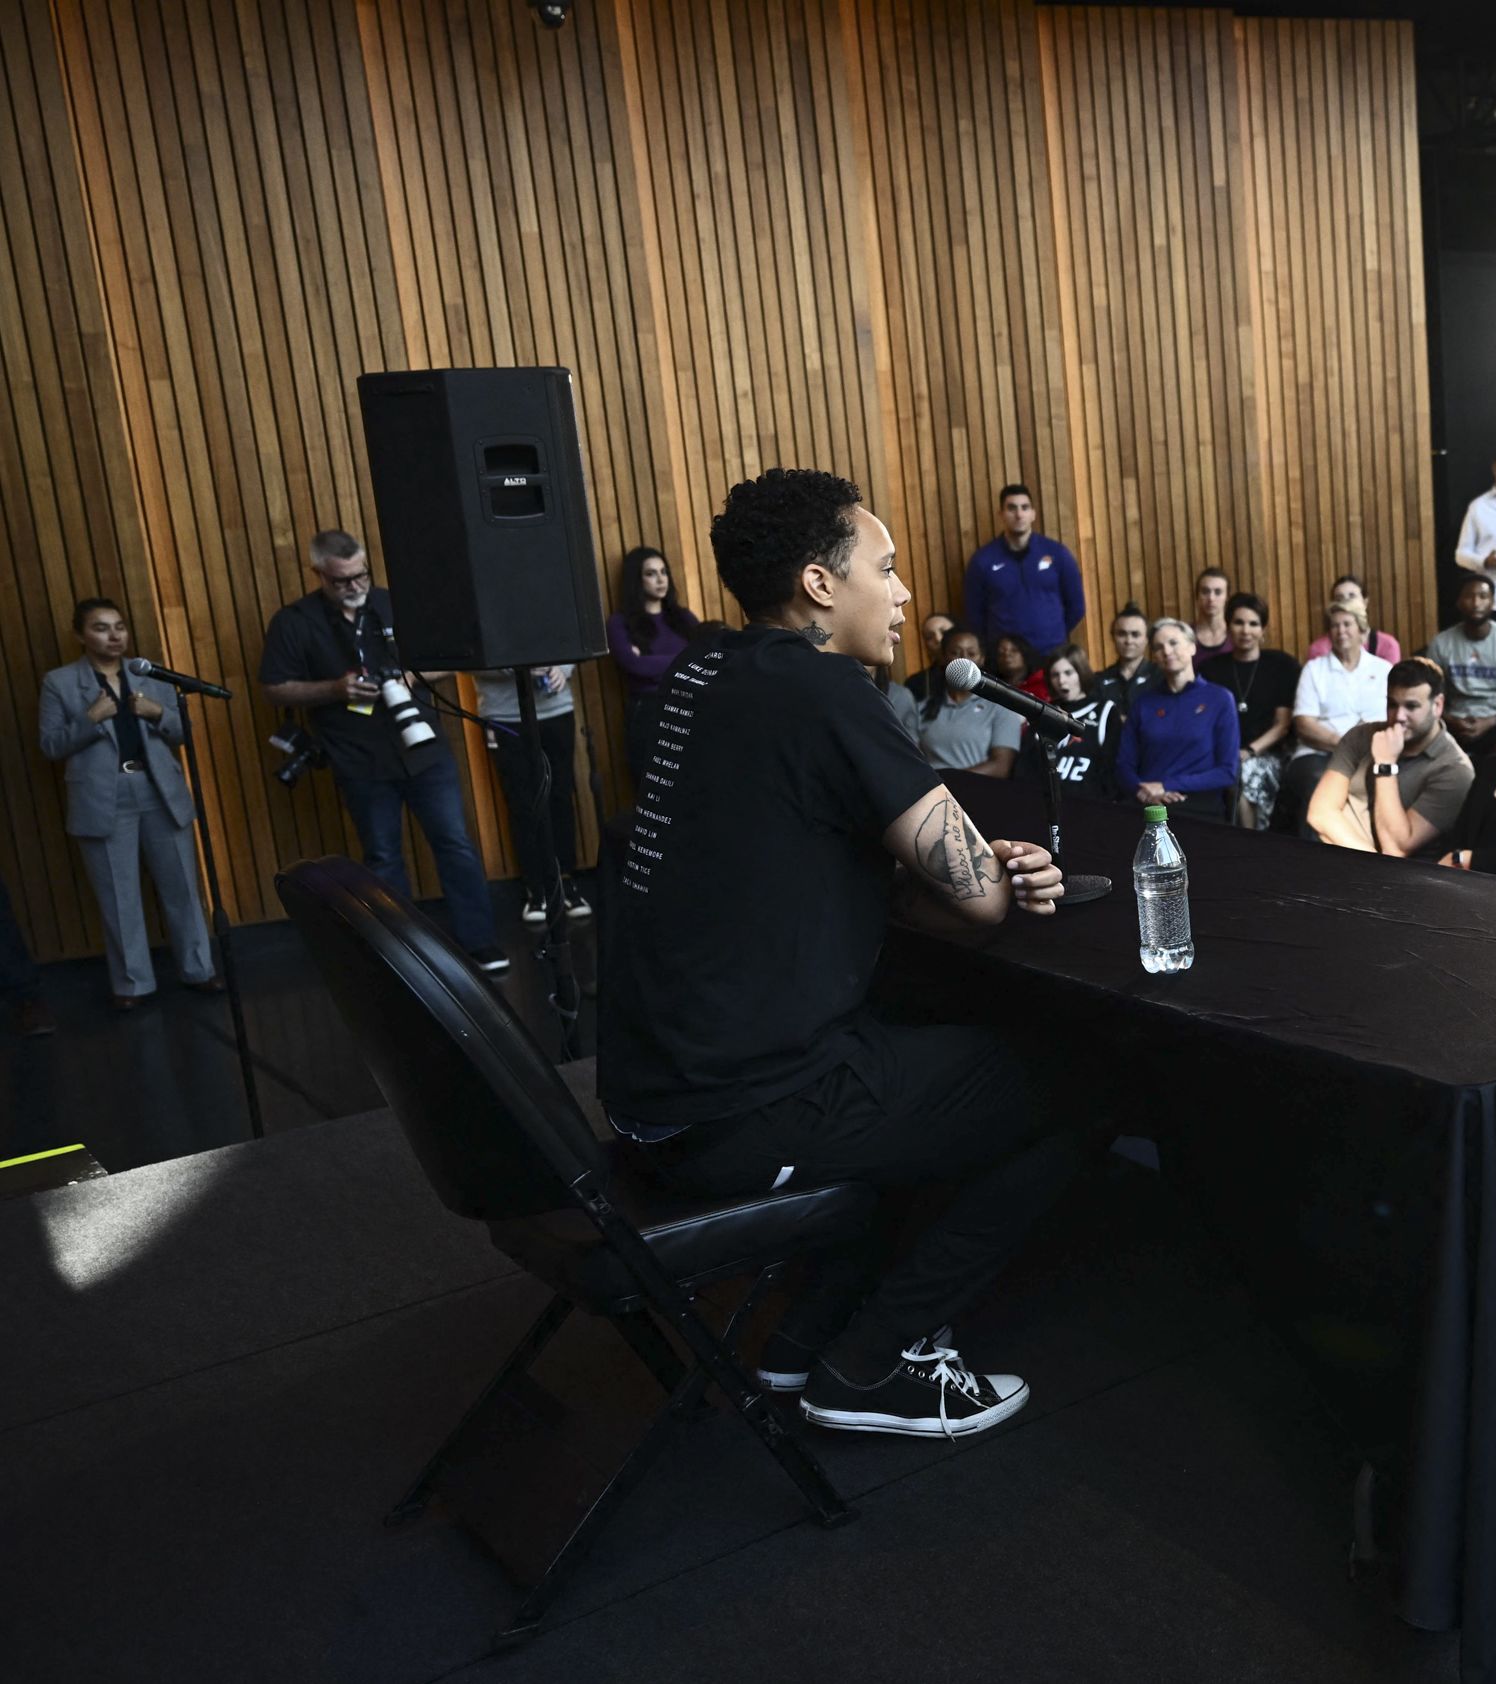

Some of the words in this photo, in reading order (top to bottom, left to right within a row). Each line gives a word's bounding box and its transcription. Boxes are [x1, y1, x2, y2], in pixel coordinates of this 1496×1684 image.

[1056, 756, 1091, 782] 42
[644, 811, 672, 825] HERNANDEZ
[953, 827, 962, 842] no
